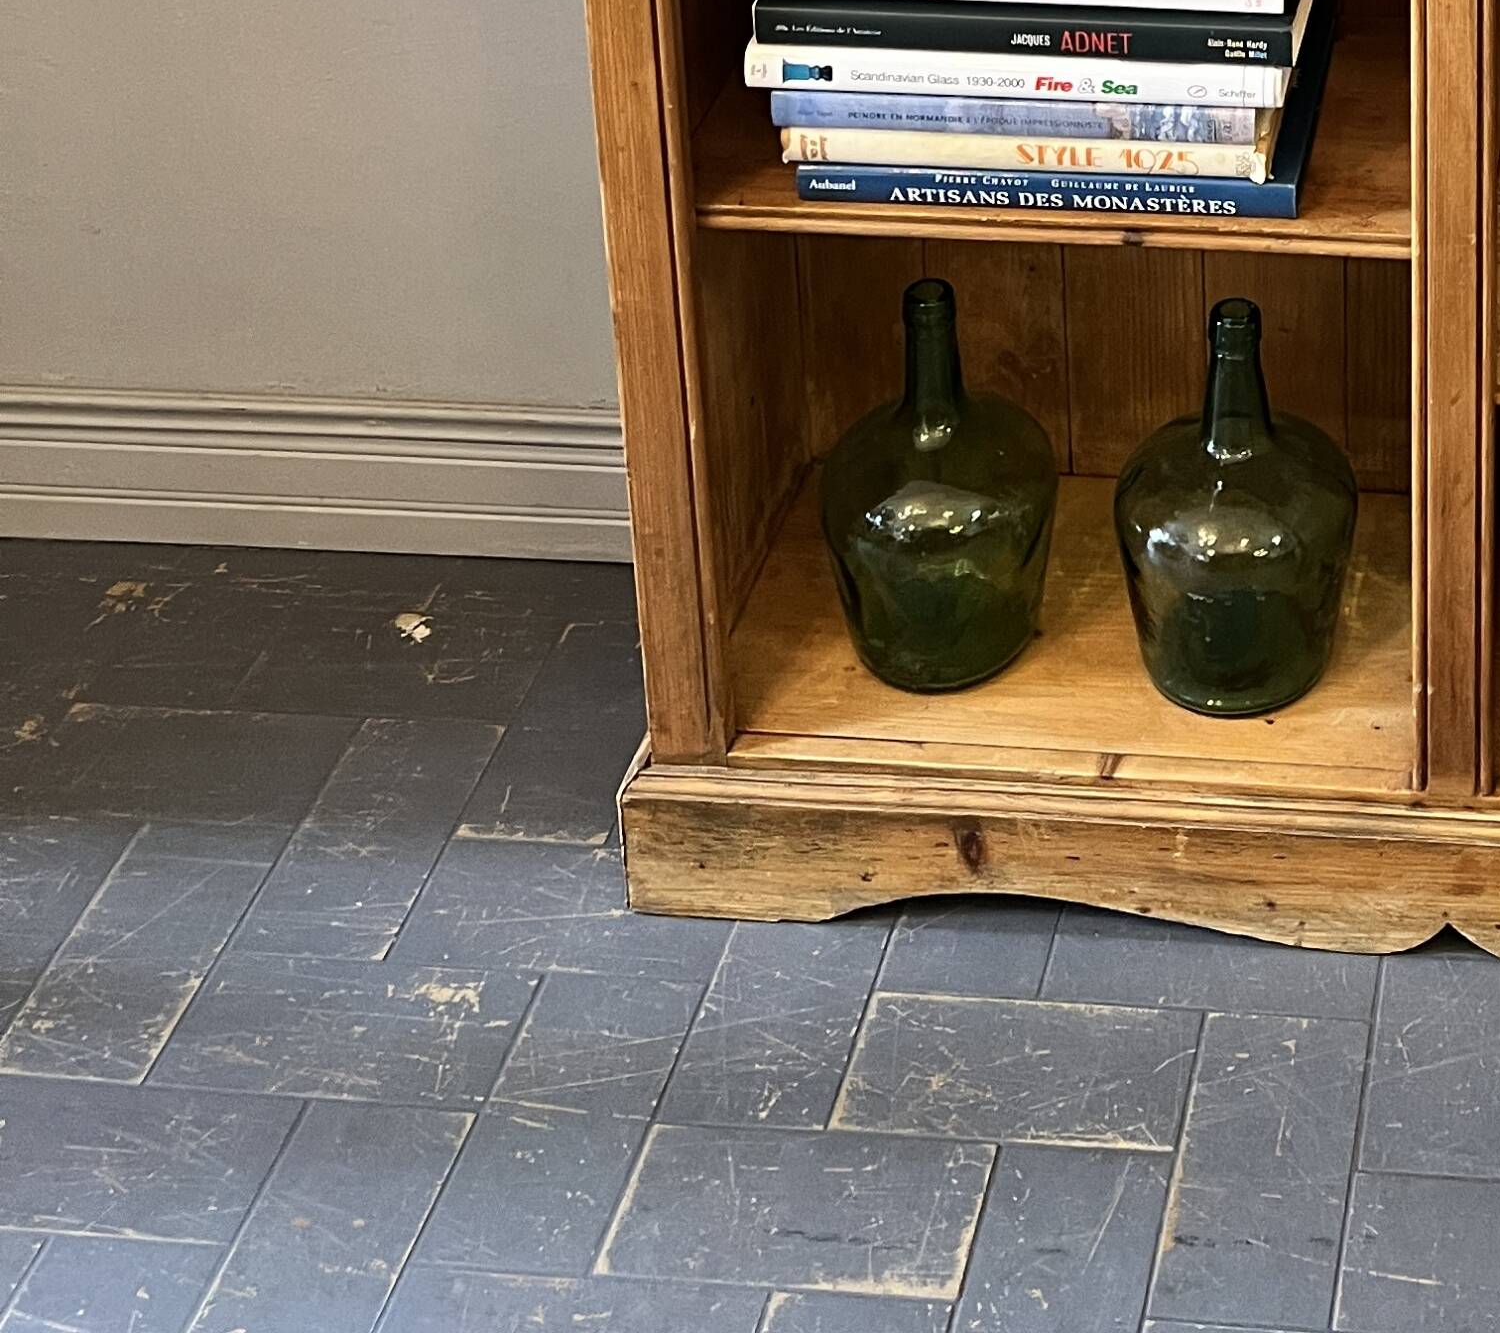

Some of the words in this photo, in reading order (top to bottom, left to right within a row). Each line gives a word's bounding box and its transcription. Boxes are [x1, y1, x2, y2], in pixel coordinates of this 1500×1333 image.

[1010, 33, 1051, 47] JACQUES
[1060, 30, 1133, 55] ADNET
[850, 69, 924, 84] Scandinavian
[927, 73, 960, 85] Glass
[966, 76, 1025, 88] 1930-2000
[1034, 76, 1074, 93] Fire
[1077, 77, 1095, 94] &
[1100, 79, 1138, 96] Sea
[1218, 87, 1256, 99] Schiffer
[890, 112, 902, 120] EN
[1015, 143, 1102, 169] STYLE
[1118, 147, 1201, 175] 1925
[808, 179, 856, 191] Aubanel
[889, 187, 1010, 206] ARTISANS
[1018, 191, 1065, 208] DES
[1072, 193, 1237, 215] MONASTÈRES
